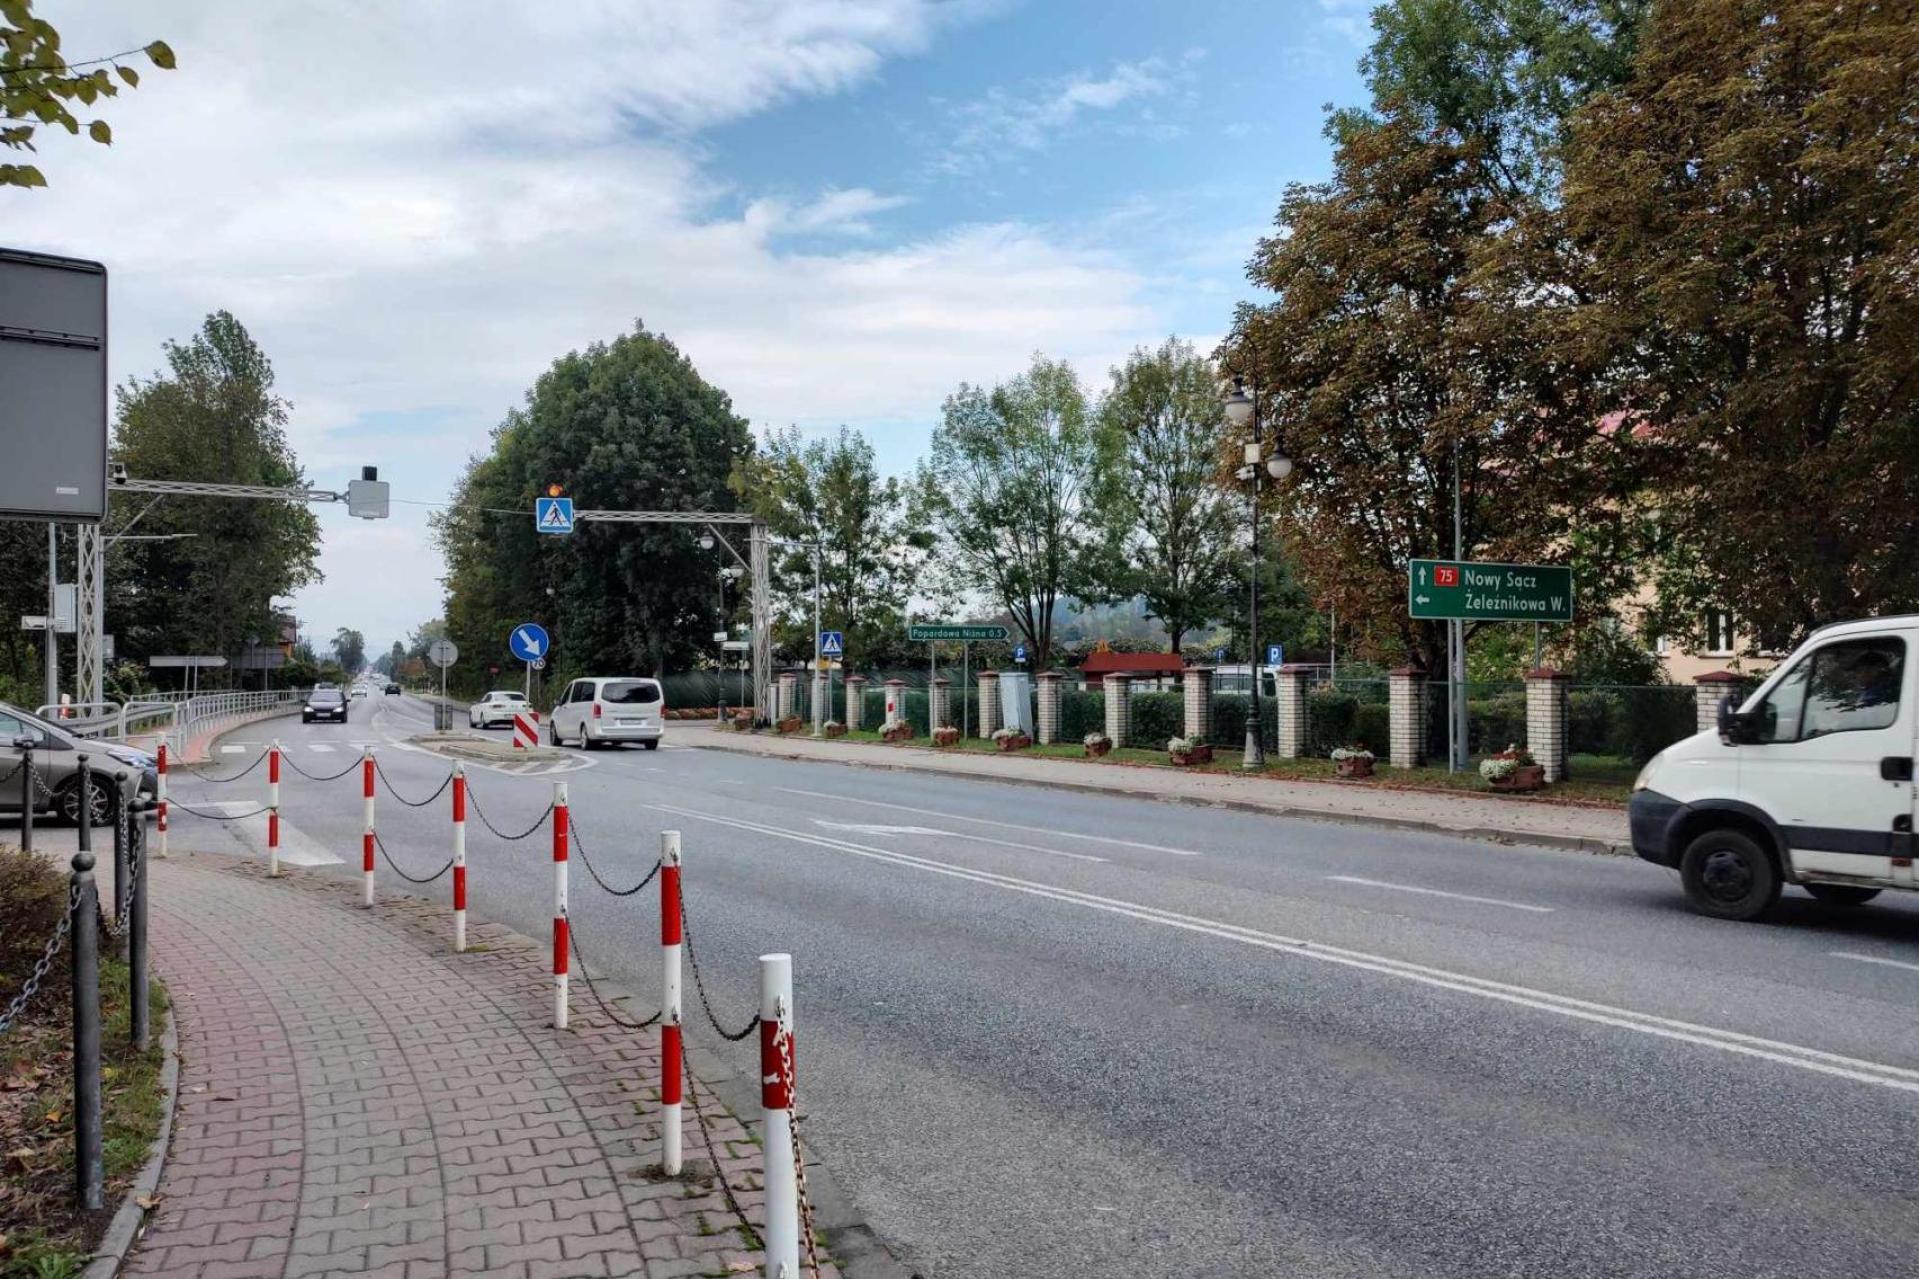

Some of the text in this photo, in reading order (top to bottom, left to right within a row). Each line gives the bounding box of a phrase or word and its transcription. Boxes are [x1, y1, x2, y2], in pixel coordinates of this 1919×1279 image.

[1440, 570, 1536, 591] 75 Nowy Sącz
[1465, 589, 1566, 612] Żeleźnikowa W.
[1271, 647, 1279, 662] P
